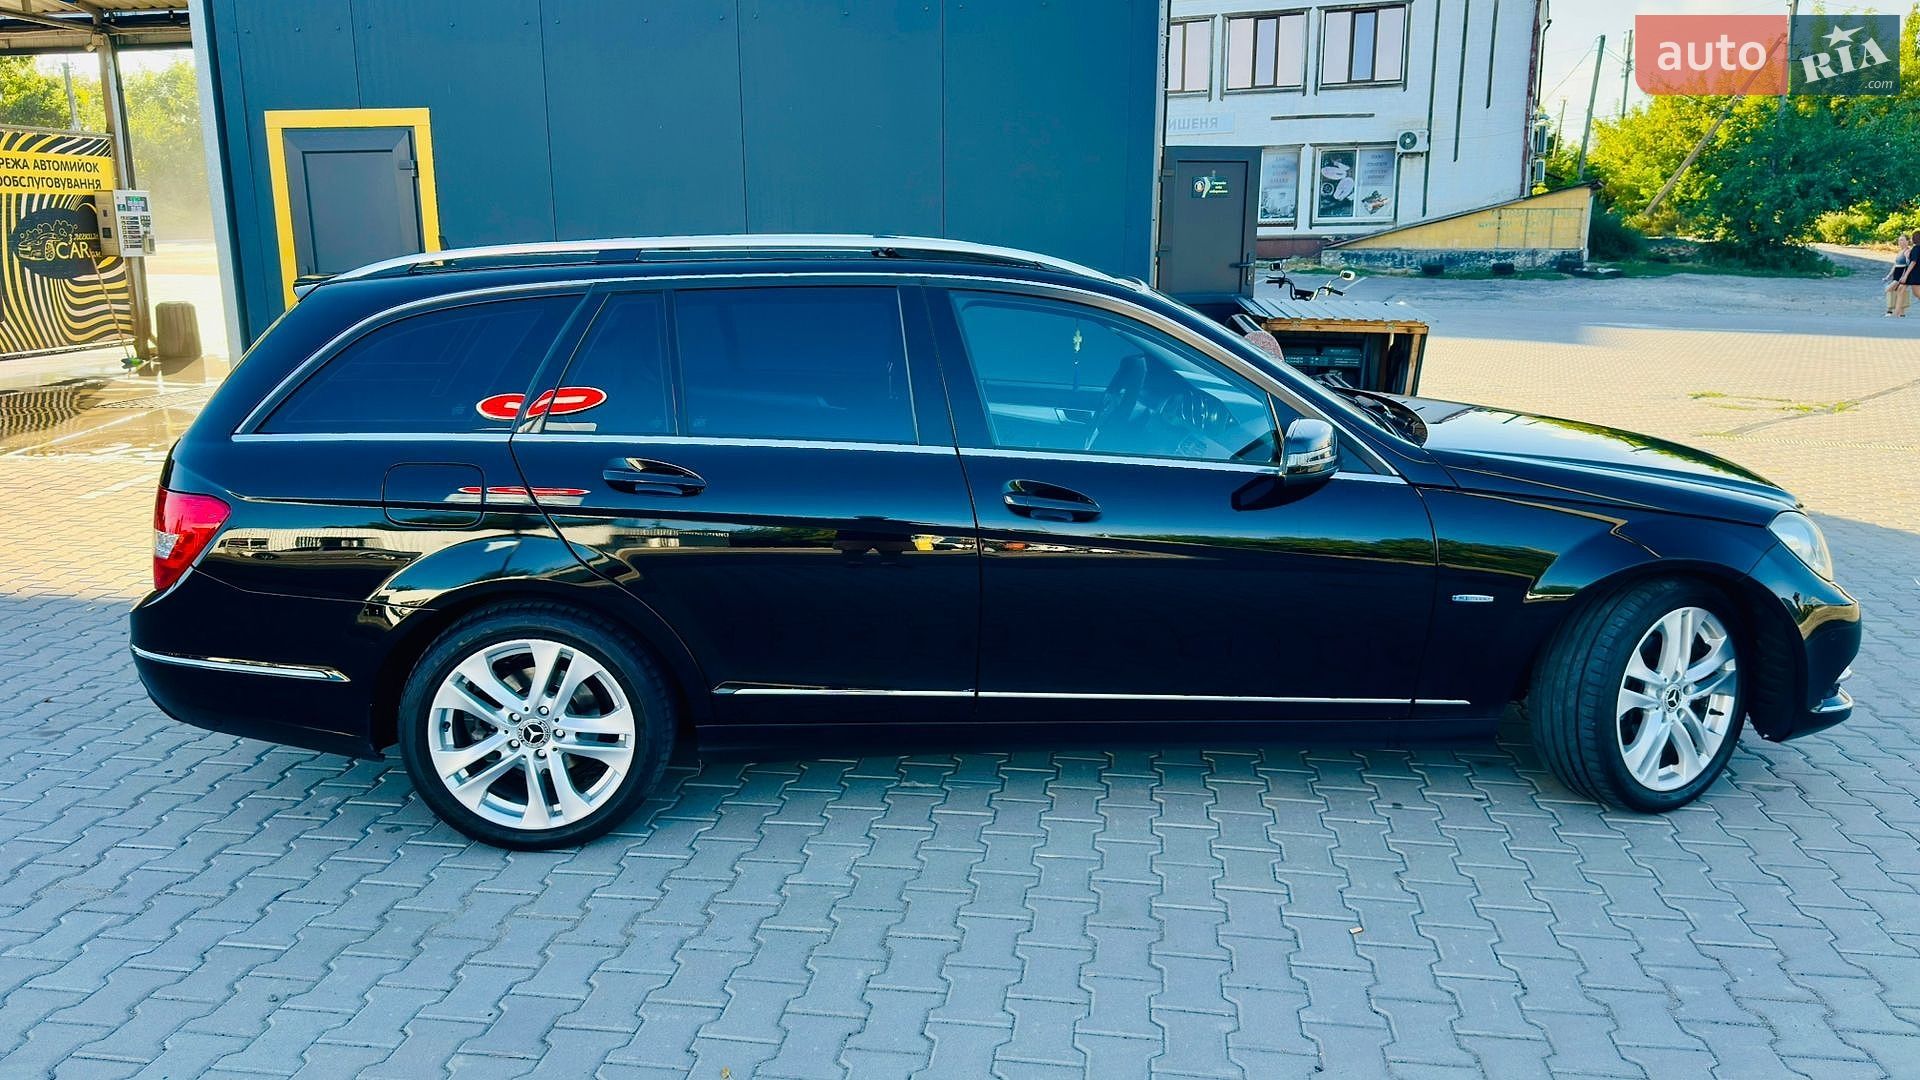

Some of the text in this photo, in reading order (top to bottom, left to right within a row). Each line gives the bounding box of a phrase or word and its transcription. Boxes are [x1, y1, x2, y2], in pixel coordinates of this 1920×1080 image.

[33, 158, 100, 173] АВТОМИЙОК
[0, 175, 102, 190] ОБСЛУГОВУВАННЯ
[56, 241, 91, 260] CAR
